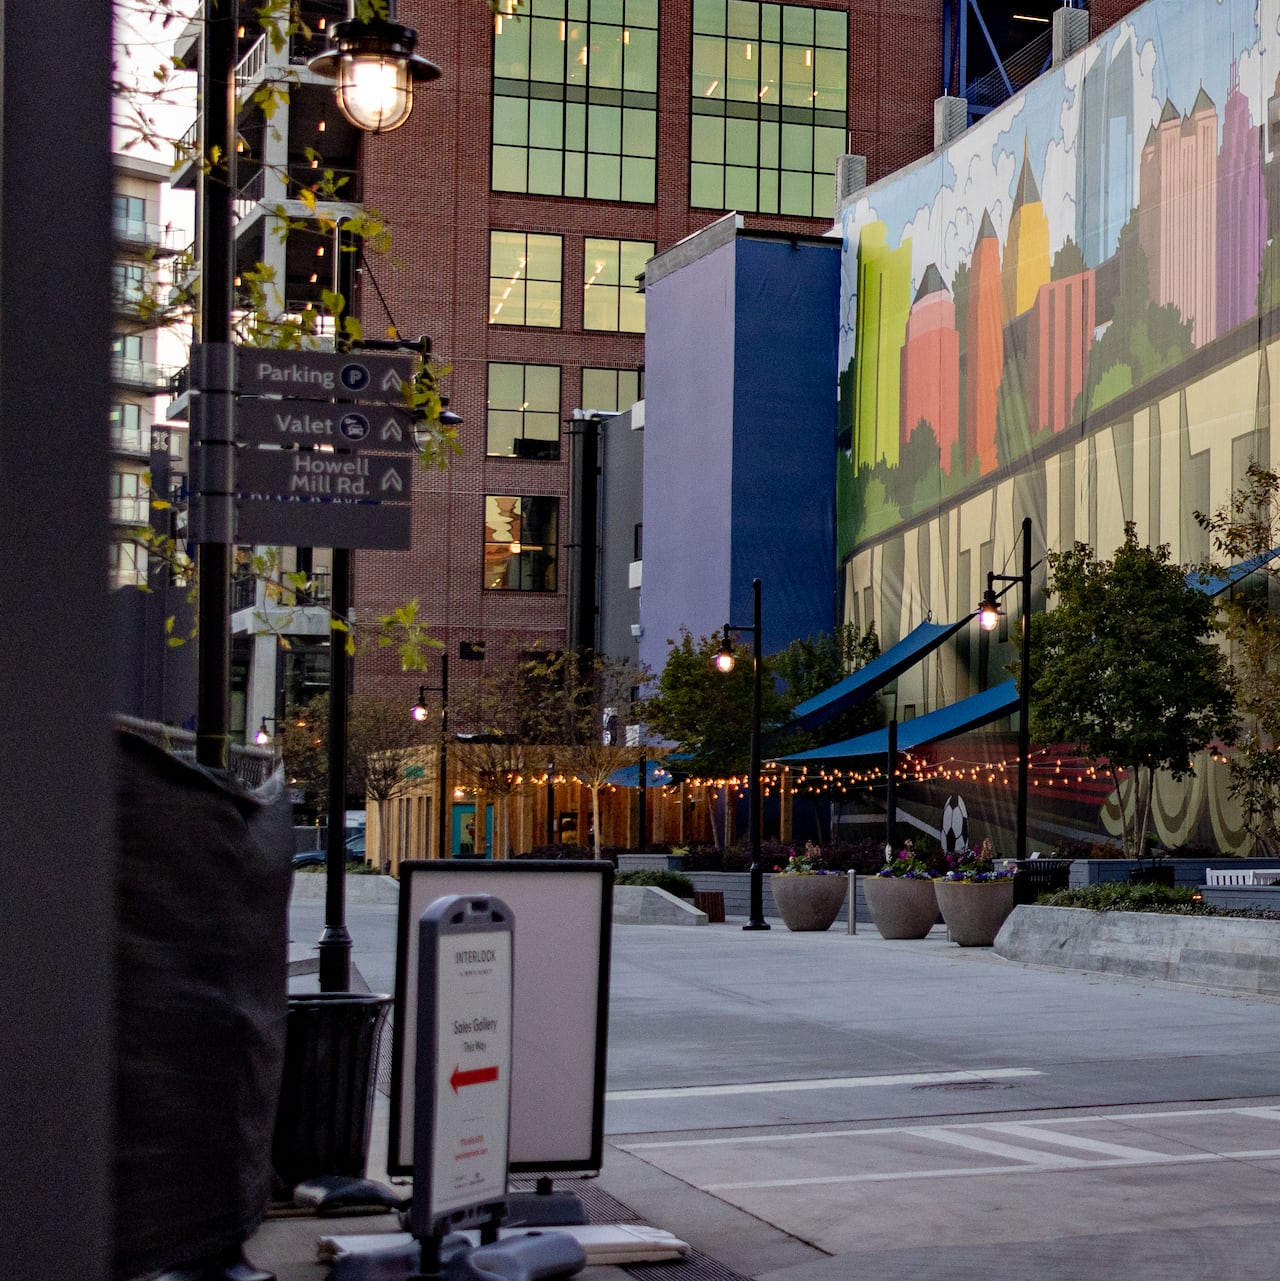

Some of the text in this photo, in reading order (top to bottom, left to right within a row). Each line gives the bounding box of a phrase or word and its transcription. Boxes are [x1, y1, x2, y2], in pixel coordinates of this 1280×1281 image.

[258, 363, 335, 388] Parking
[276, 412, 334, 434] Valet
[294, 454, 371, 476] Howell
[291, 473, 370, 495] Mill Rd.
[456, 949, 497, 964] INTERLOCK
[454, 1017, 498, 1035] Sales Gallery
